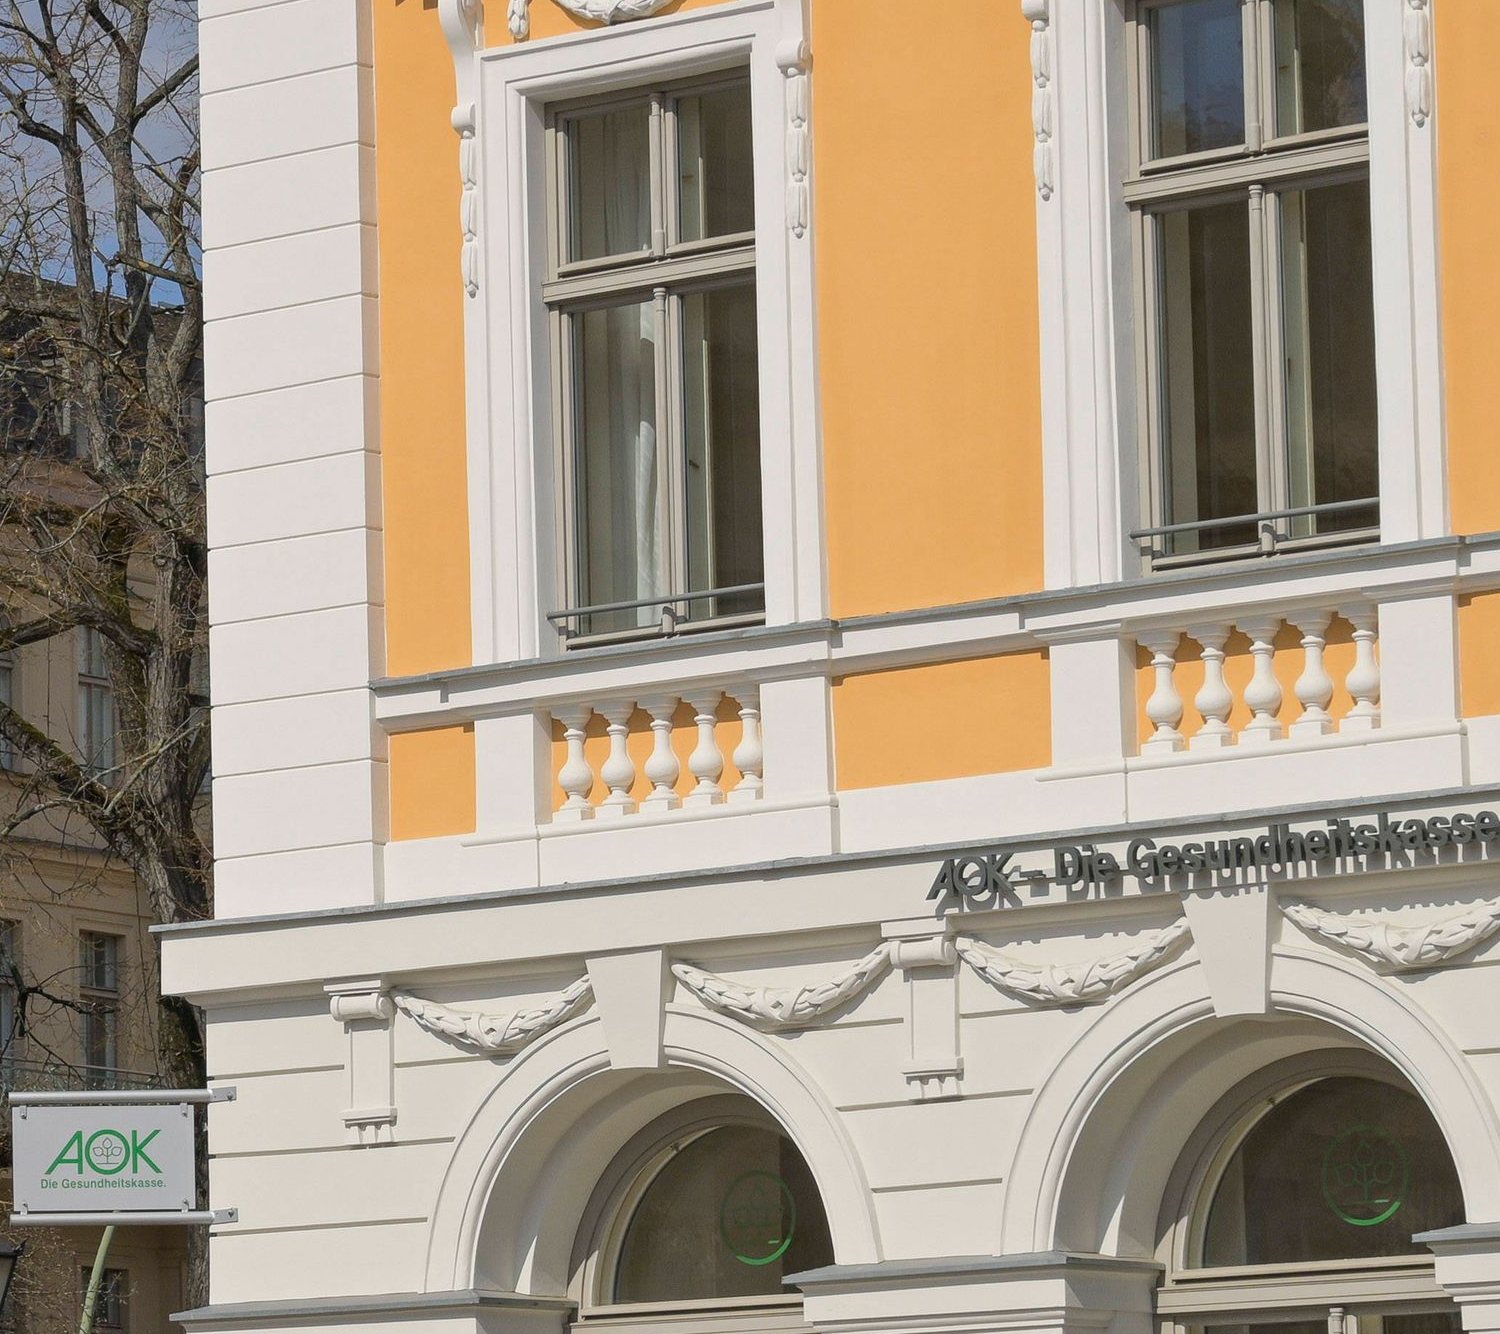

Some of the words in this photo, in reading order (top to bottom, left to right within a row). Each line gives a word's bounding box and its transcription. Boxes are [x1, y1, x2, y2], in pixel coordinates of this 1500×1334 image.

[925, 851, 1016, 900] AOK
[1055, 844, 1118, 886] Die
[44, 1129, 163, 1175] AOK
[41, 1178, 58, 1189] Die
[61, 1178, 167, 1189] Gesundheitskasse.
